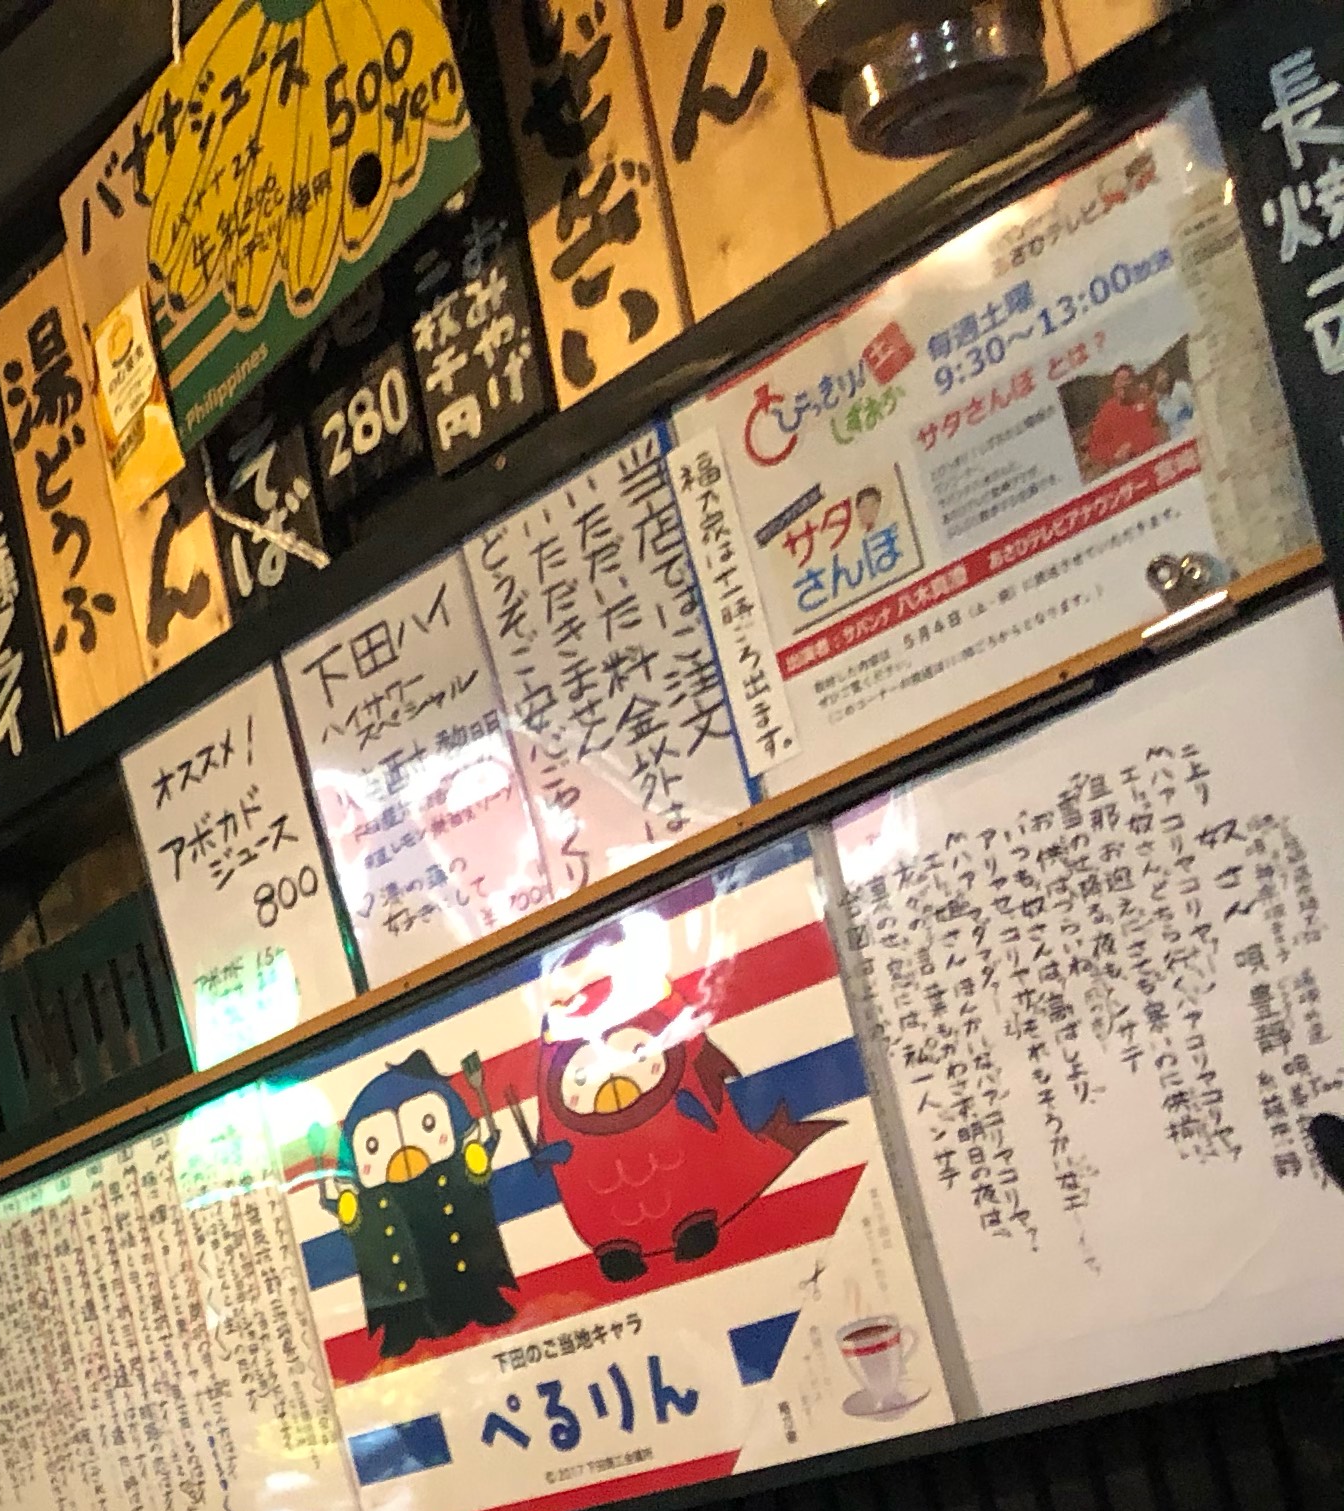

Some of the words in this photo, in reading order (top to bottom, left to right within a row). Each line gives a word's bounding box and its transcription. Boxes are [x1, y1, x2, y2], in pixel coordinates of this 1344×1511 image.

[324, 28, 413, 148] 500
[185, 342, 269, 431] Philippines
[321, 367, 410, 478] 280
[2, 306, 117, 654] 湯どうふ
[782, 498, 853, 568] サタ
[793, 522, 906, 614] さんぽ
[301, 580, 451, 706] 下田ハイ
[157, 784, 266, 881] アボカド
[208, 815, 300, 890] ジュース
[253, 865, 318, 929] 800
[493, 1312, 646, 1375] 下田のご当地キャラ
